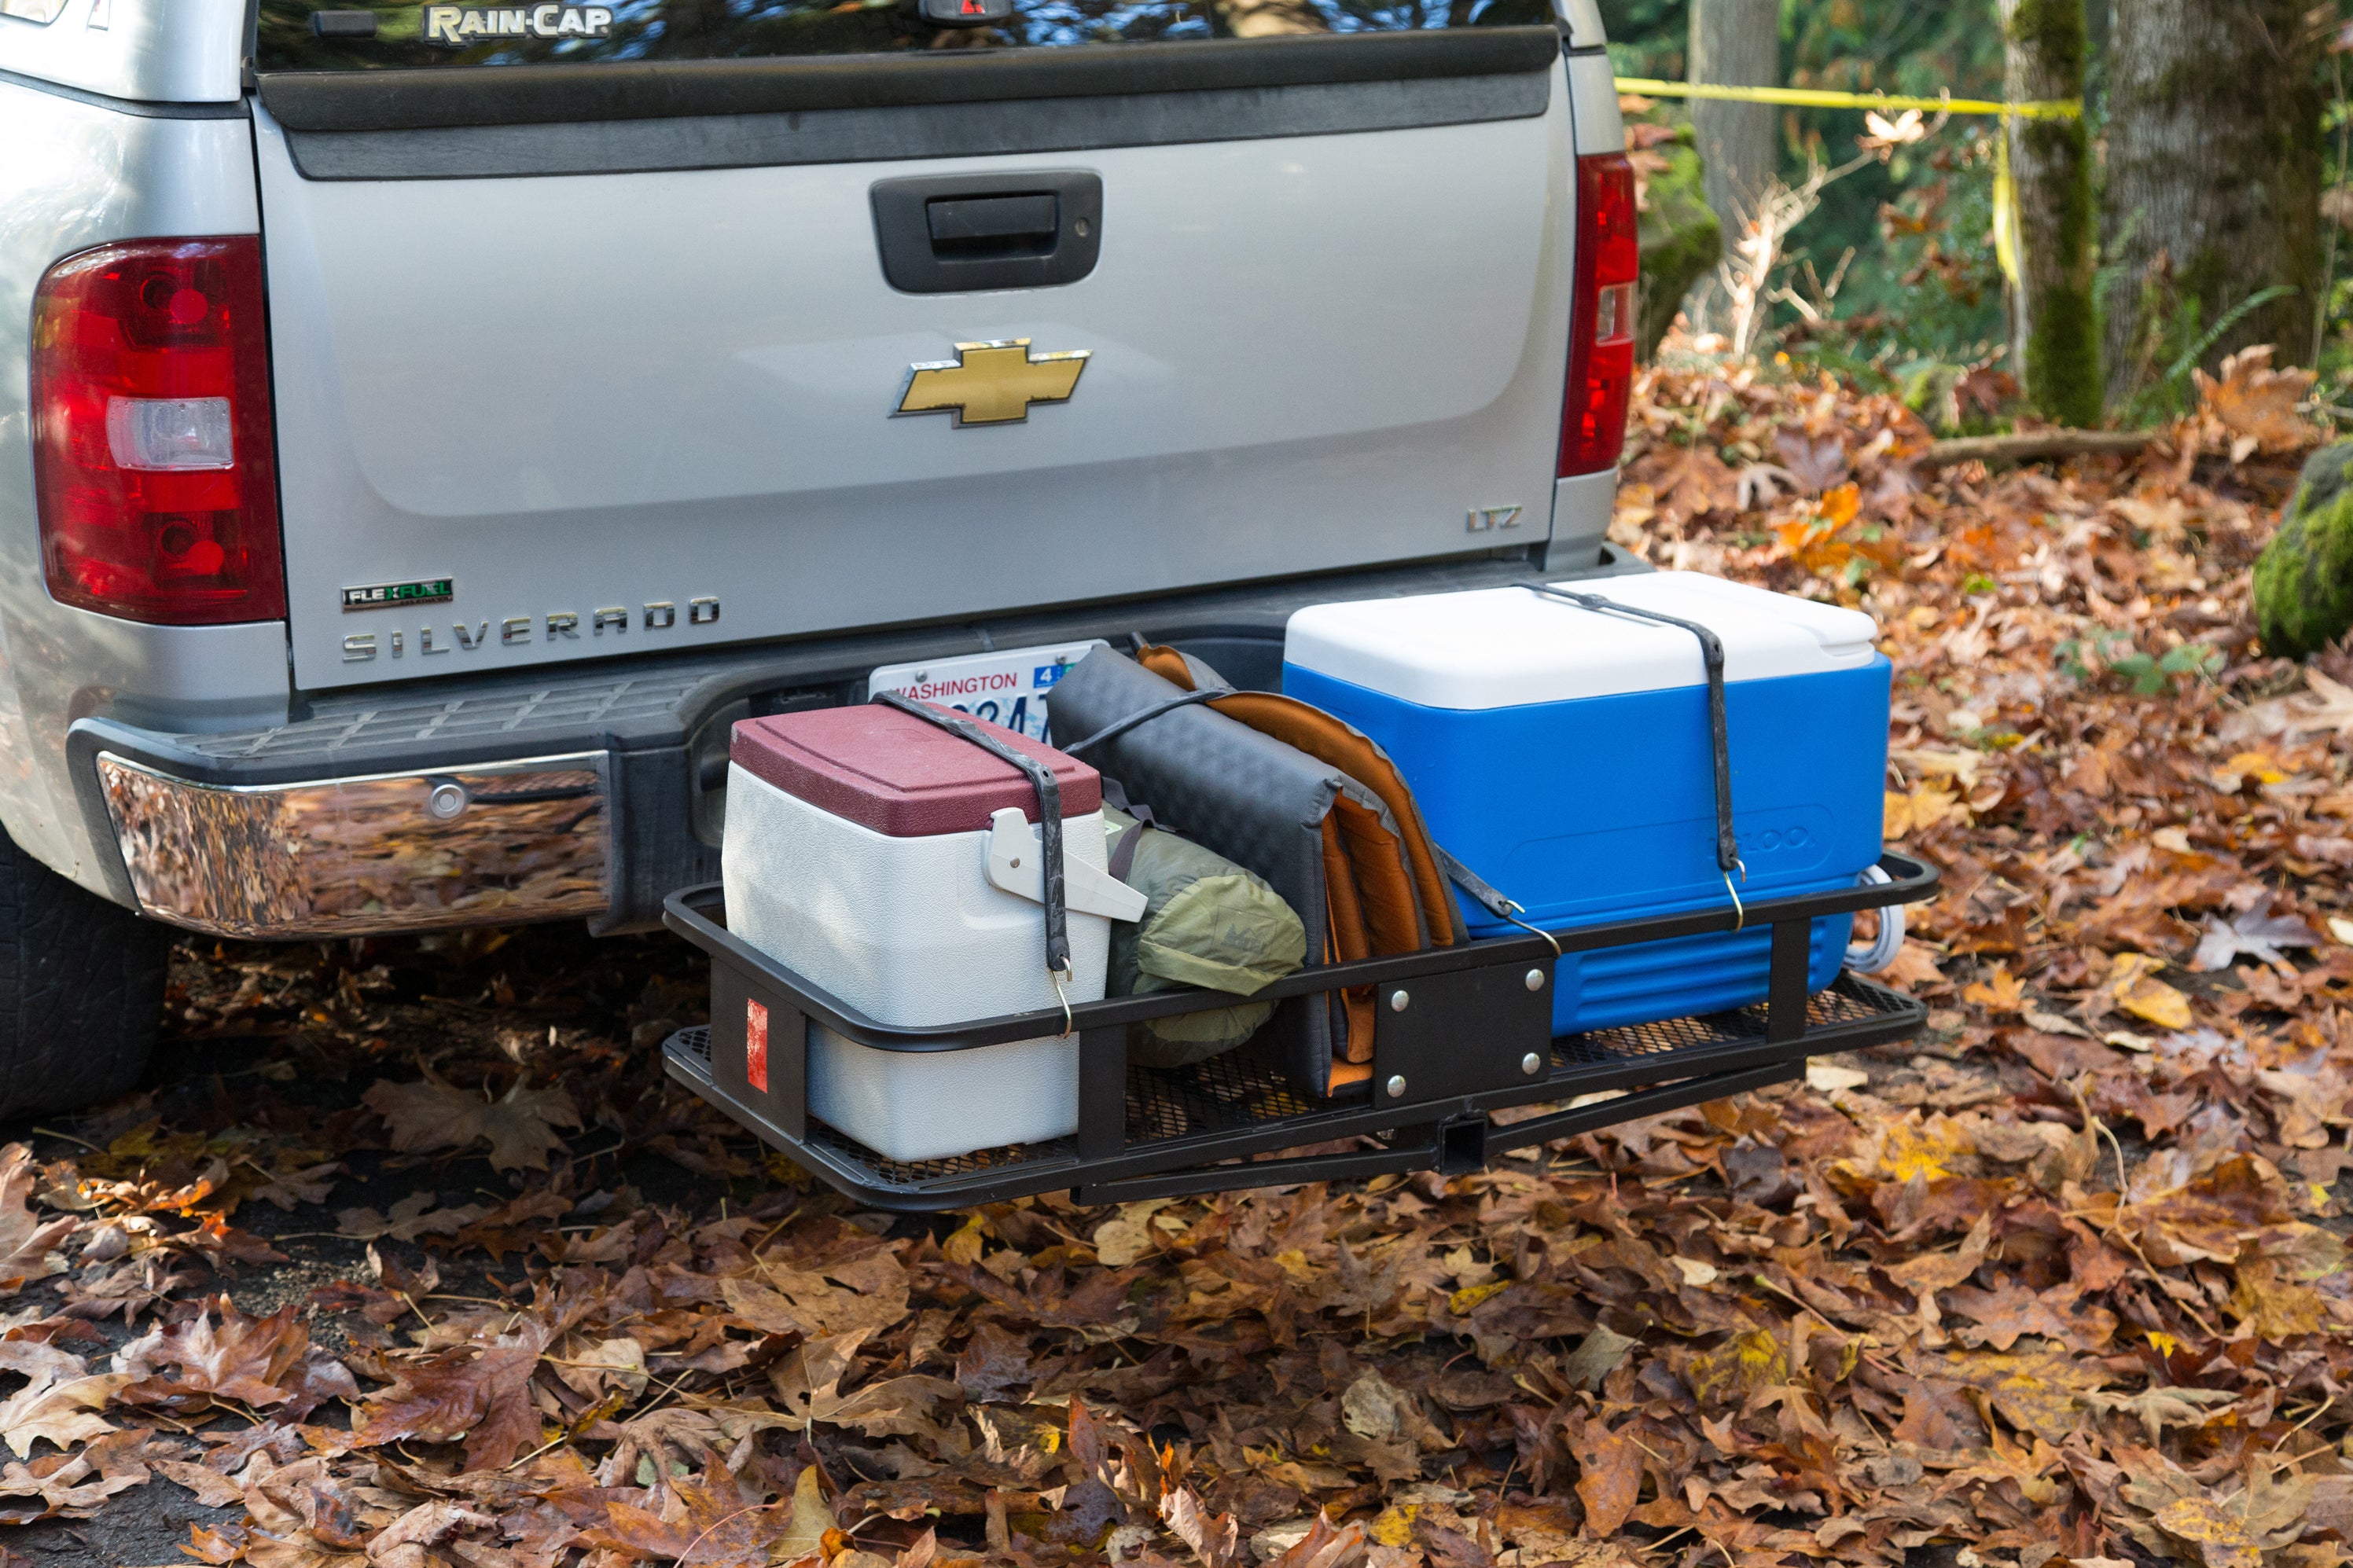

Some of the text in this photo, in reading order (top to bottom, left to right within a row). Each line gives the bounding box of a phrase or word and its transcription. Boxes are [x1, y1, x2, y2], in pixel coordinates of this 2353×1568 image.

[428, 5, 611, 42] RAIN-CAP
[1466, 503, 1523, 532] LTZ
[342, 596, 719, 662] SILVERADO
[1039, 667, 1052, 681] 4
